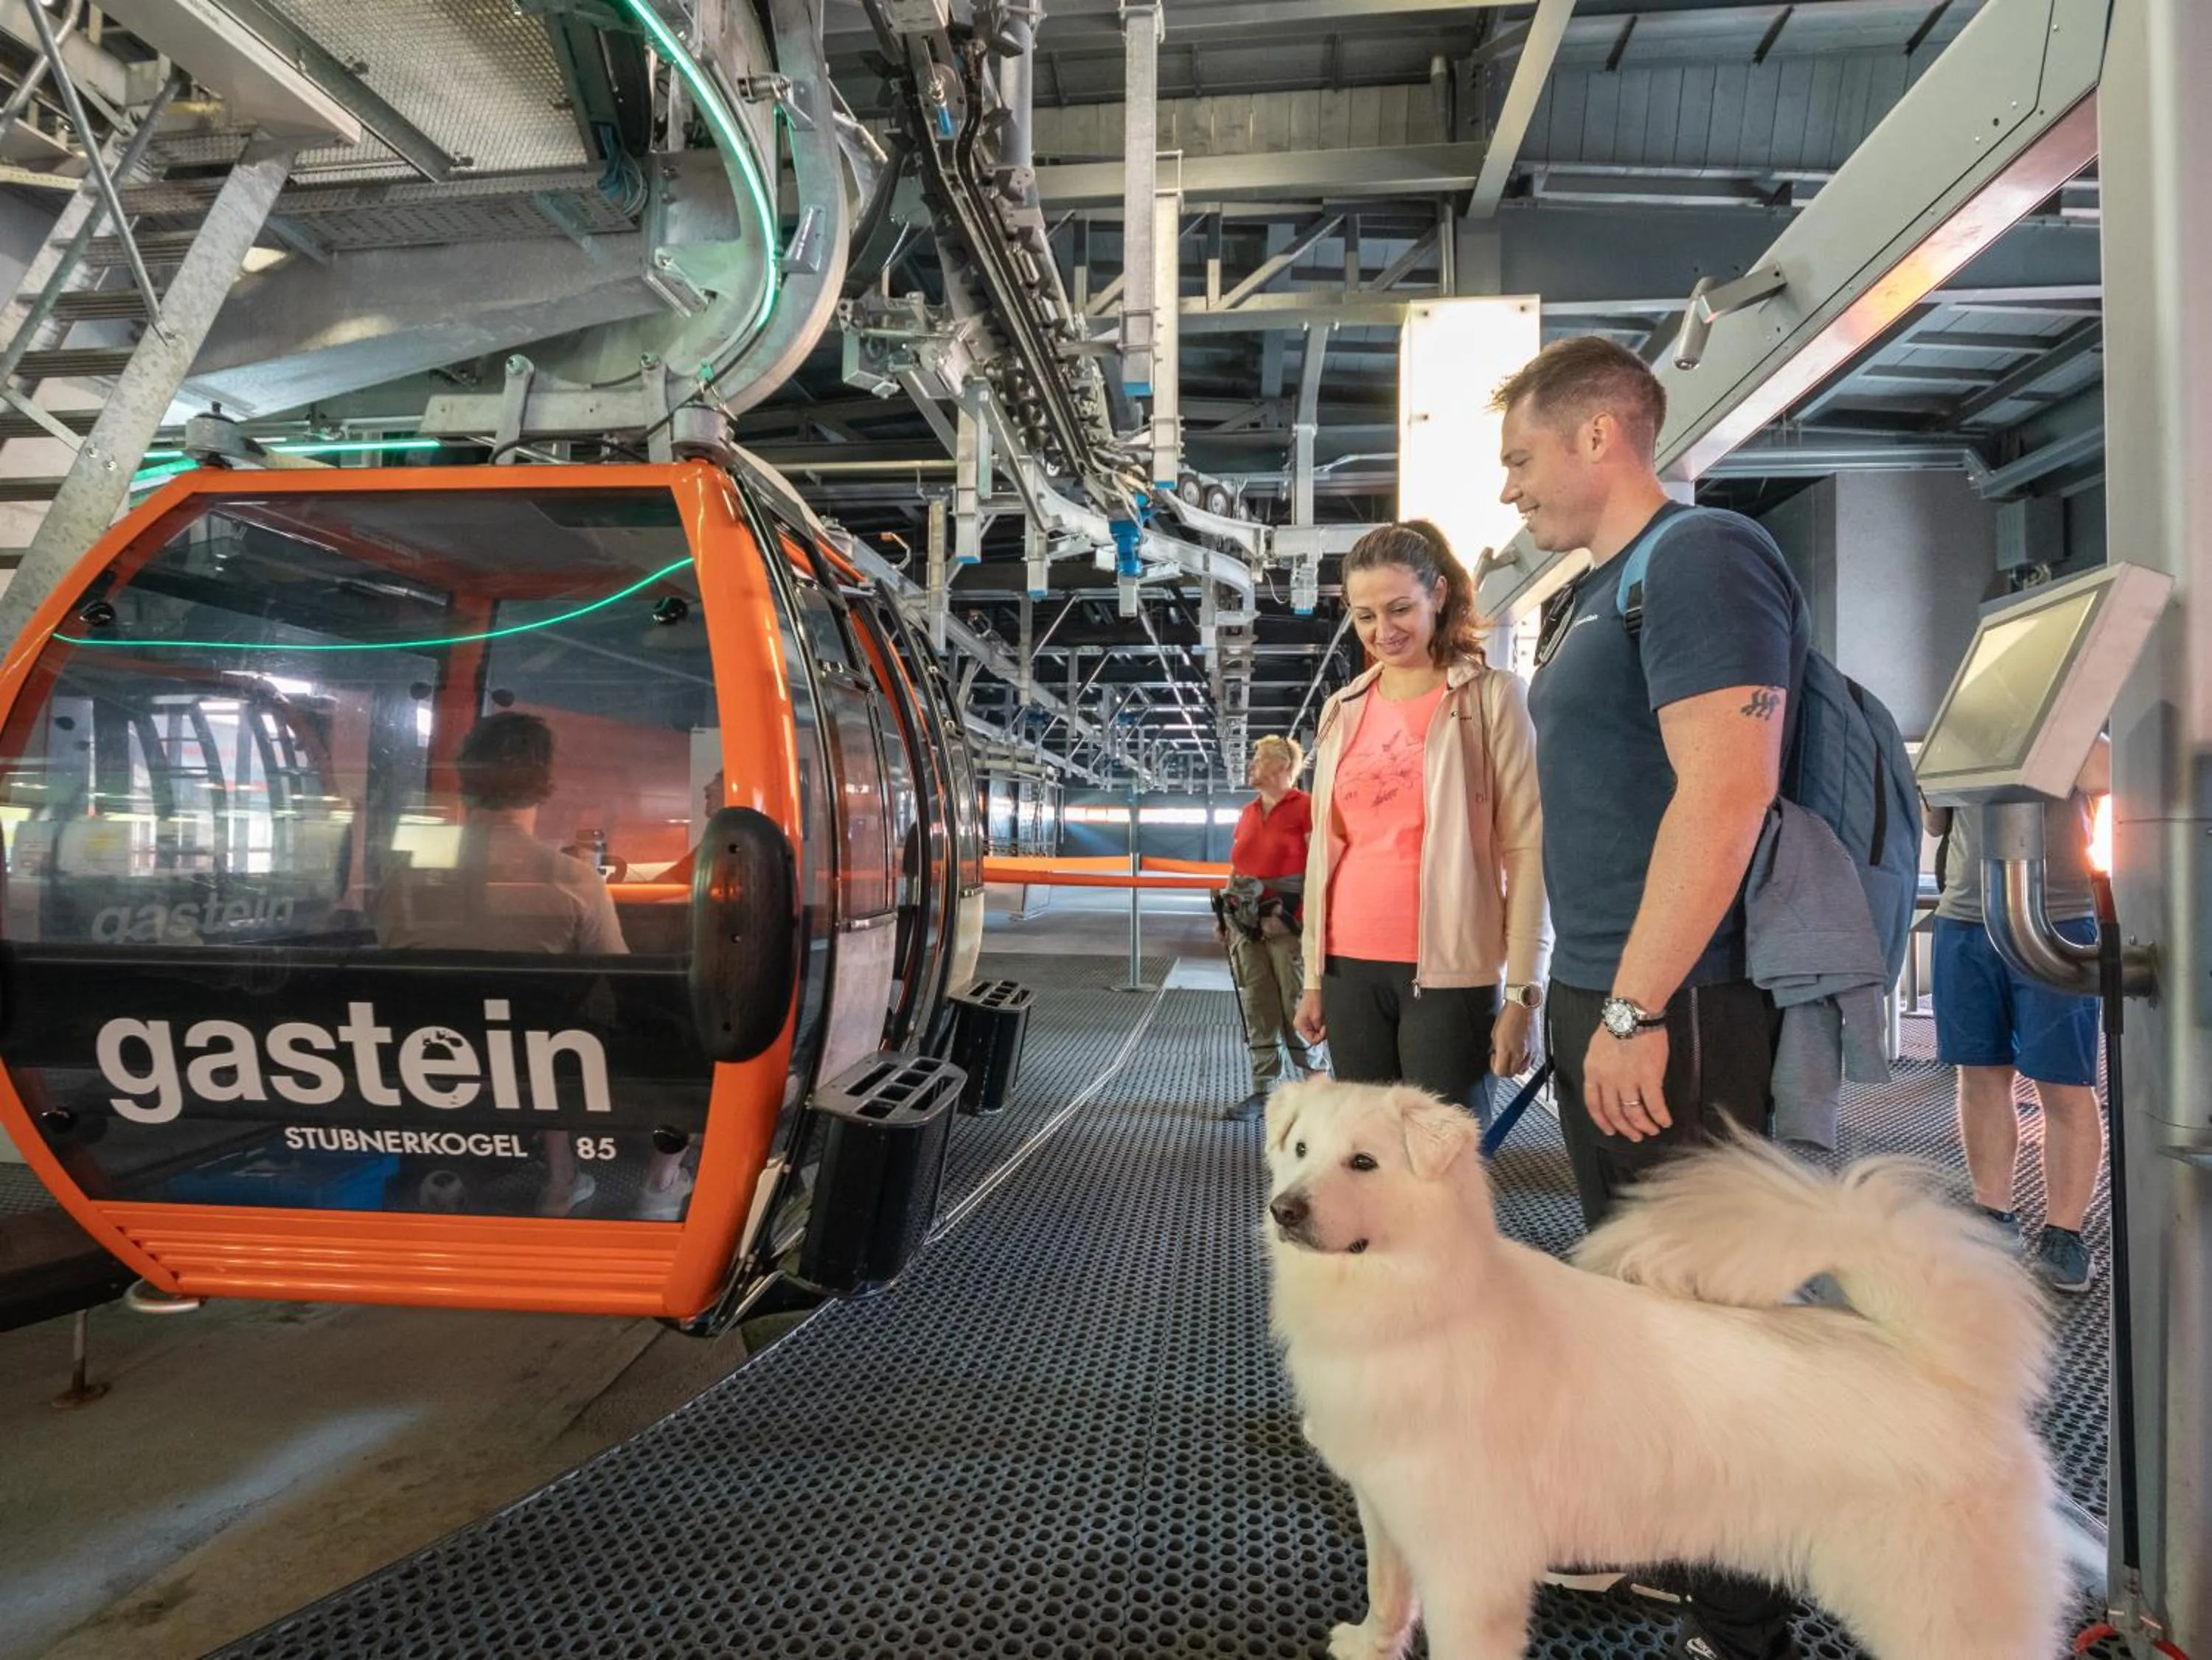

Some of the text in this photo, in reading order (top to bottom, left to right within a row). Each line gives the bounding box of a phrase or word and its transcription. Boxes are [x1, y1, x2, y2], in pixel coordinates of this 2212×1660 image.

[97, 1000, 611, 1124] gastein
[285, 1127, 616, 1160] STUBNERKOGEL 85
